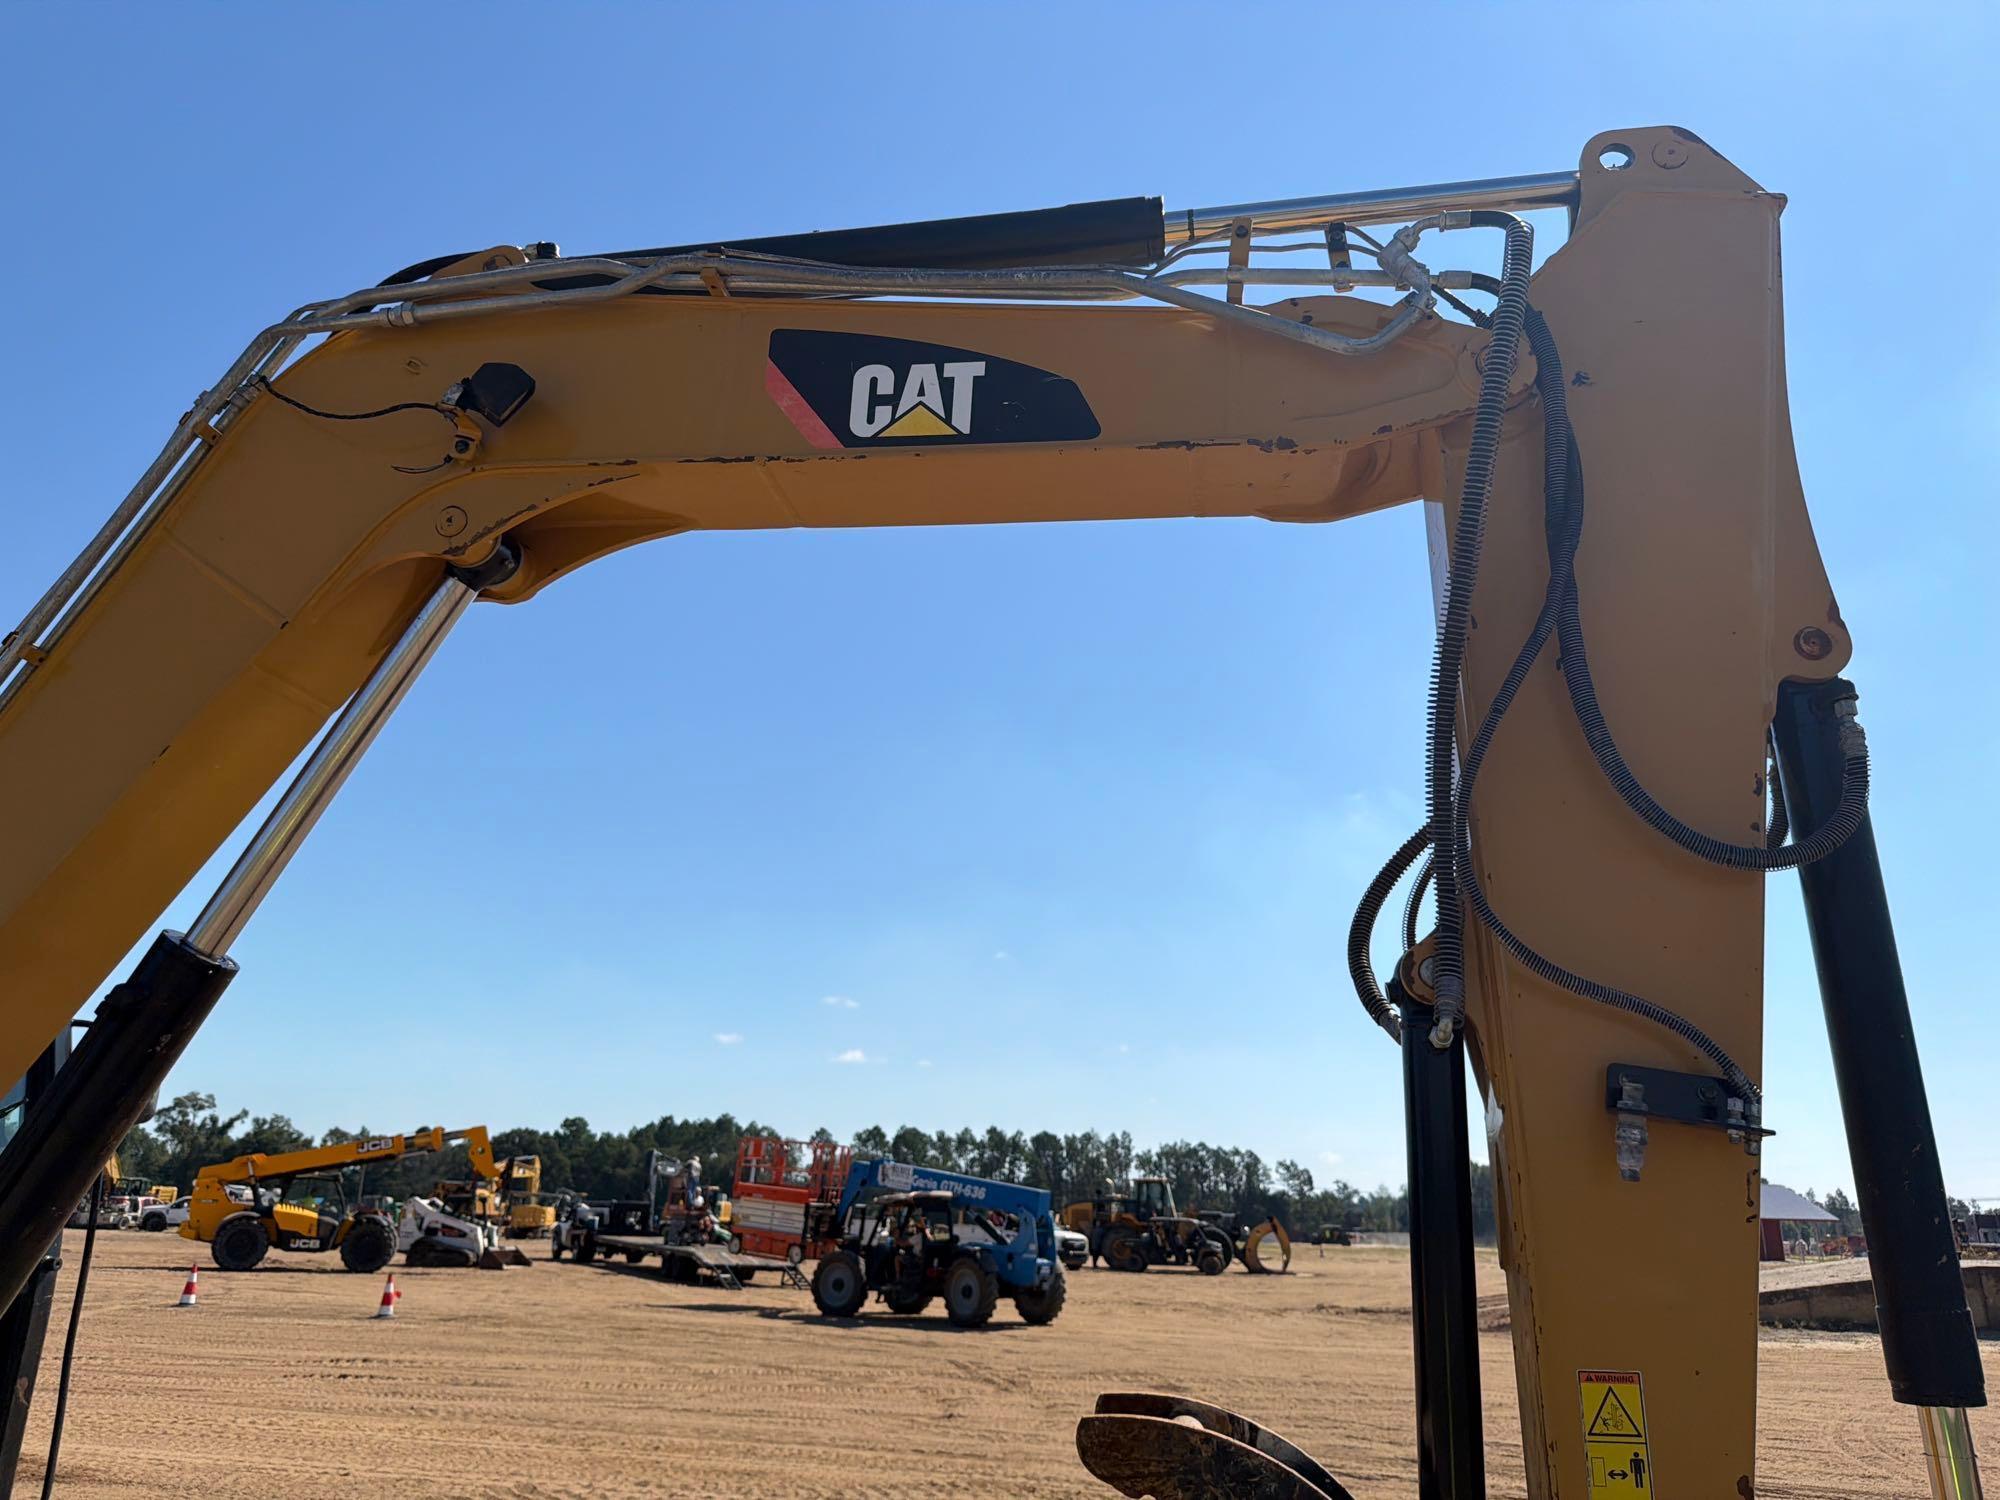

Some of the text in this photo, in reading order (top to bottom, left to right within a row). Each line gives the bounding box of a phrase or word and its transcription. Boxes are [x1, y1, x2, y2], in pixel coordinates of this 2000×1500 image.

[849, 361, 986, 438] CAT
[358, 1139, 392, 1152] JCB
[940, 1180, 986, 1199] GTH-636
[290, 1239, 320, 1248] JCB
[1594, 1375, 1634, 1384] WARNING
